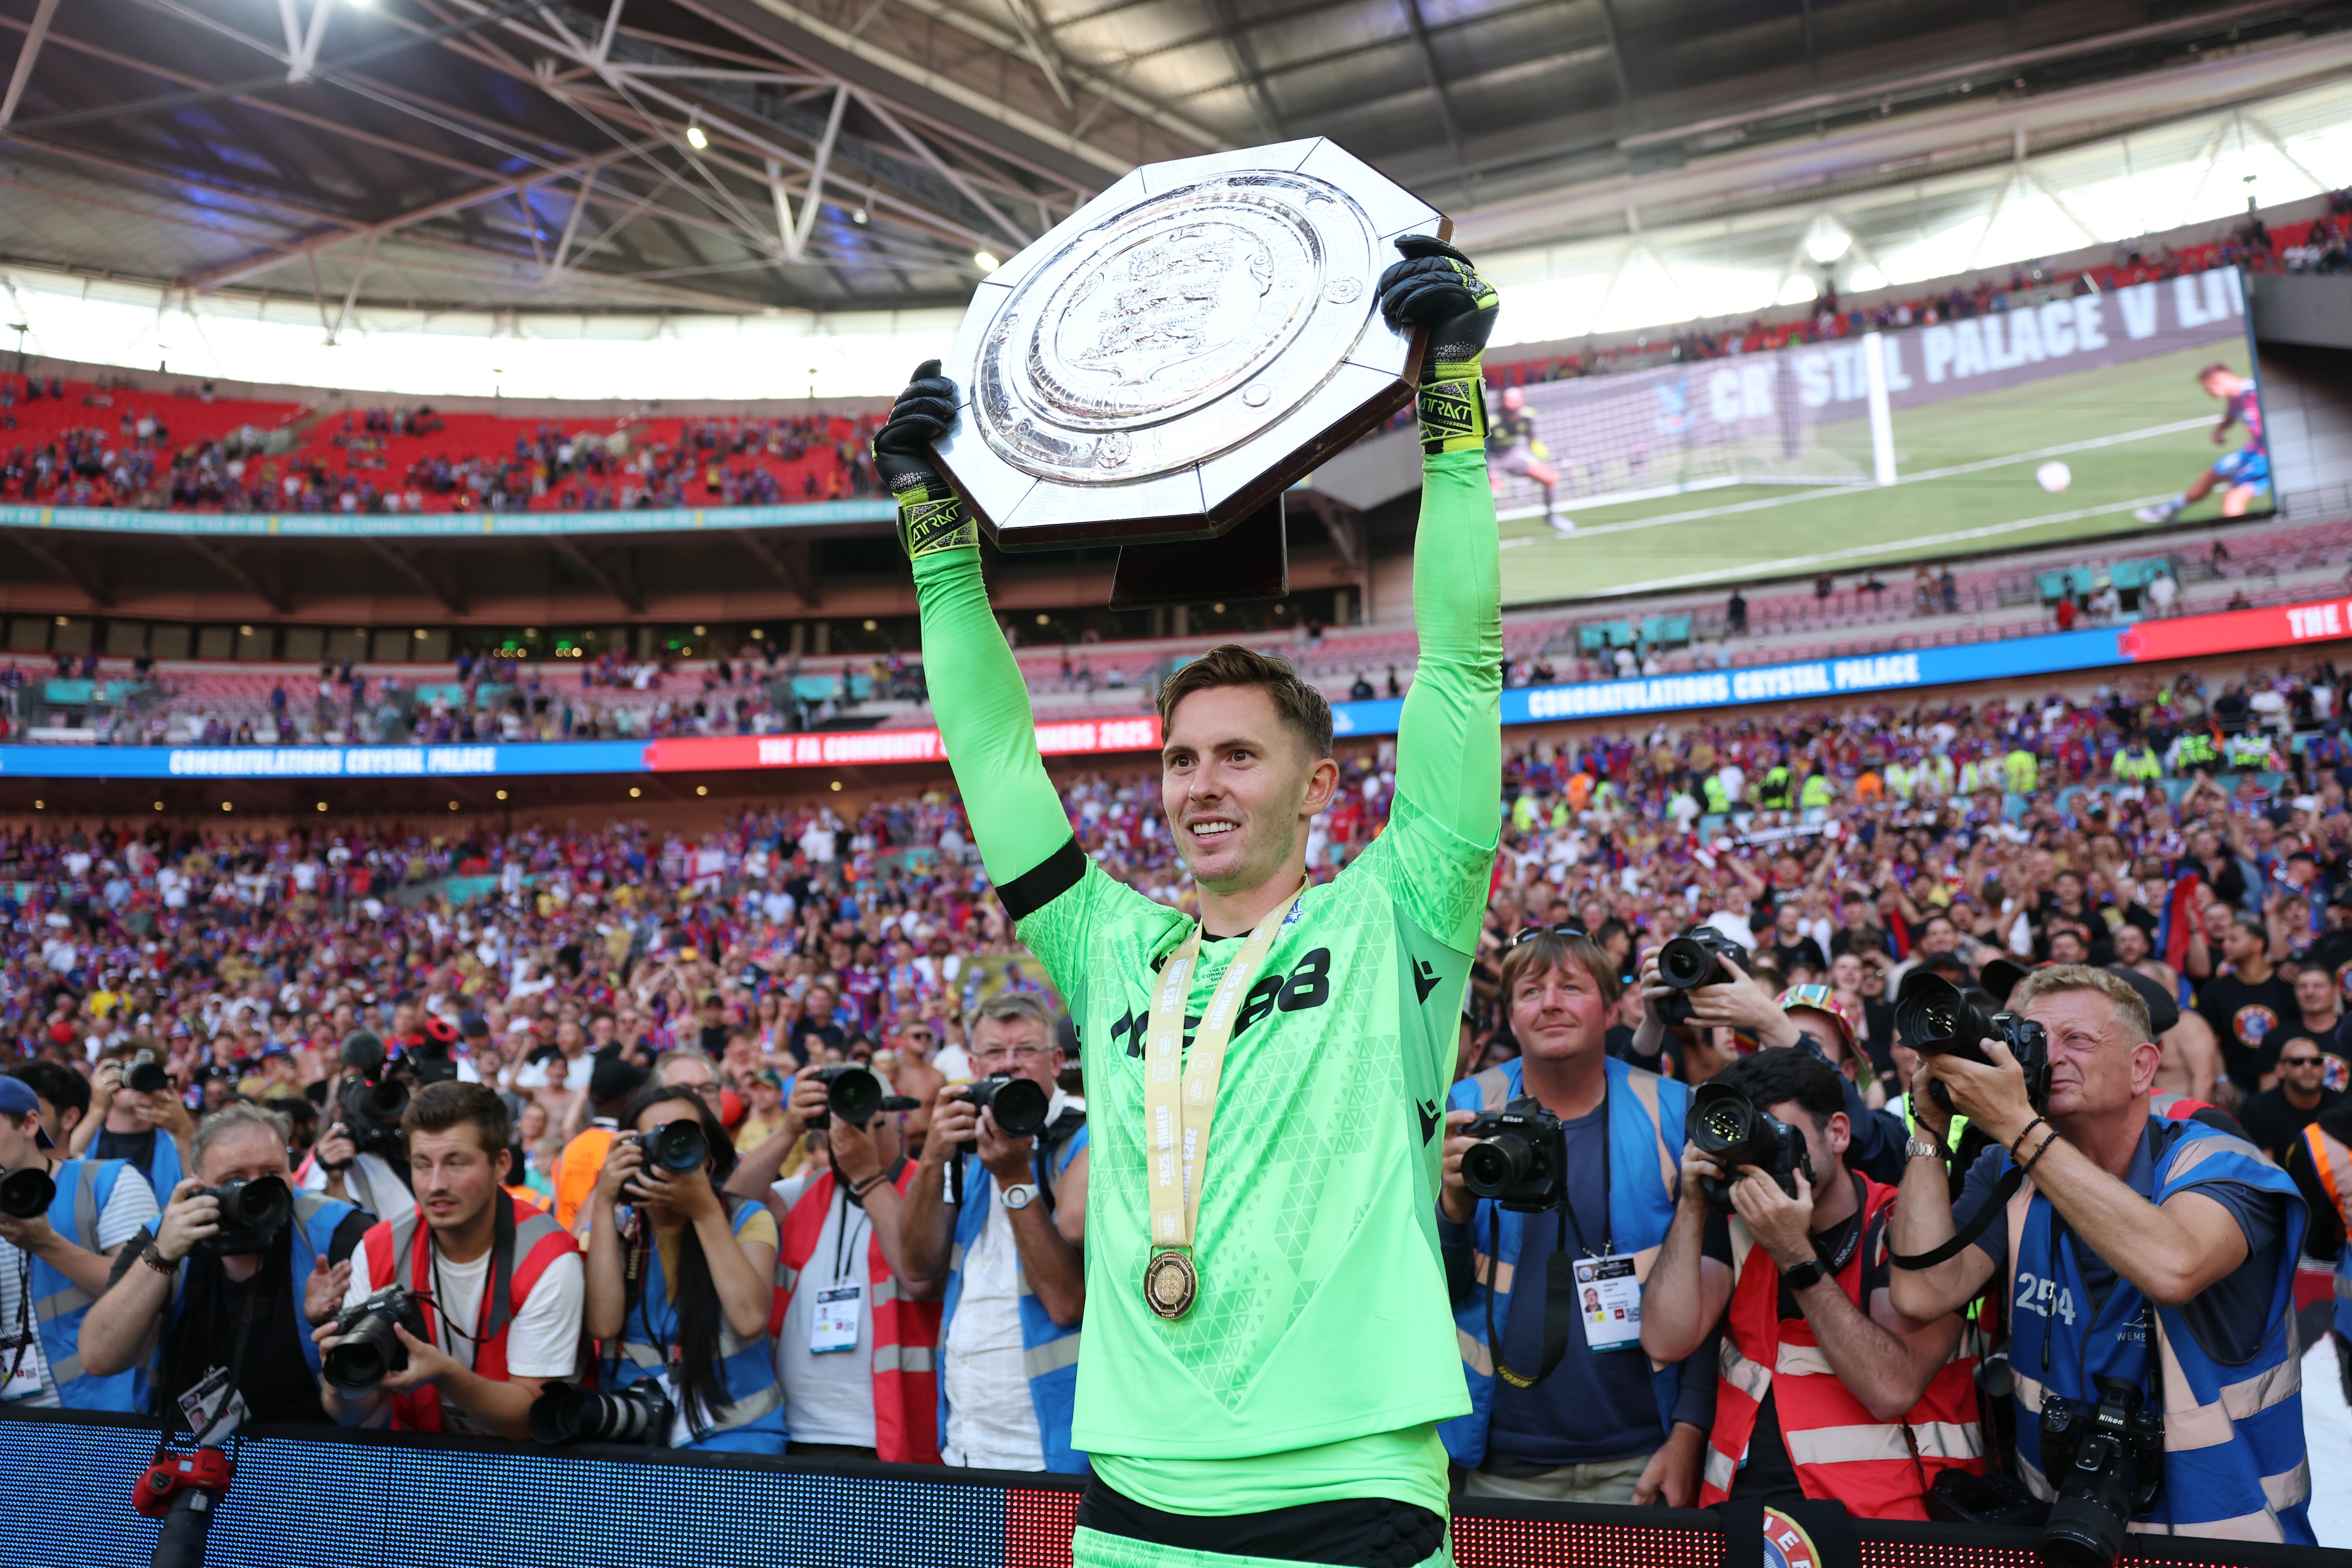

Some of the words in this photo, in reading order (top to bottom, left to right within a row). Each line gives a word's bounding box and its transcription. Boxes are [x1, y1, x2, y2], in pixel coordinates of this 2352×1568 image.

[1920, 293, 2109, 383] PALACE
[2117, 281, 2158, 340] V
[897, 475, 922, 489] reusch
[2286, 604, 2341, 639] THE
[1528, 674, 1730, 718] CONGRATULATIONS
[1733, 663, 1831, 700] CRYSTAL
[1834, 654, 1920, 690] PALACE
[758, 738, 793, 764] THE
[796, 737, 820, 763] FA
[824, 732, 938, 762] COMMUNITY
[1098, 720, 1154, 749] 2025
[169, 749, 343, 775] CONGRATULATIONS
[345, 748, 424, 774] CRYSTAL
[427, 746, 497, 773] PALACE
[1166, 958, 1187, 985] WINNER
[1229, 963, 1249, 987] 2025
[1160, 987, 1176, 1013] 2025
[1209, 992, 1235, 1029] WINNER
[1156, 1105, 1169, 1151] WINNER
[1181, 1128, 1197, 1160] 2025
[1159, 1153, 1171, 1186] 2025
[2016, 1272, 2076, 1325] 254
[2098, 1414, 2124, 1426] Nikon
